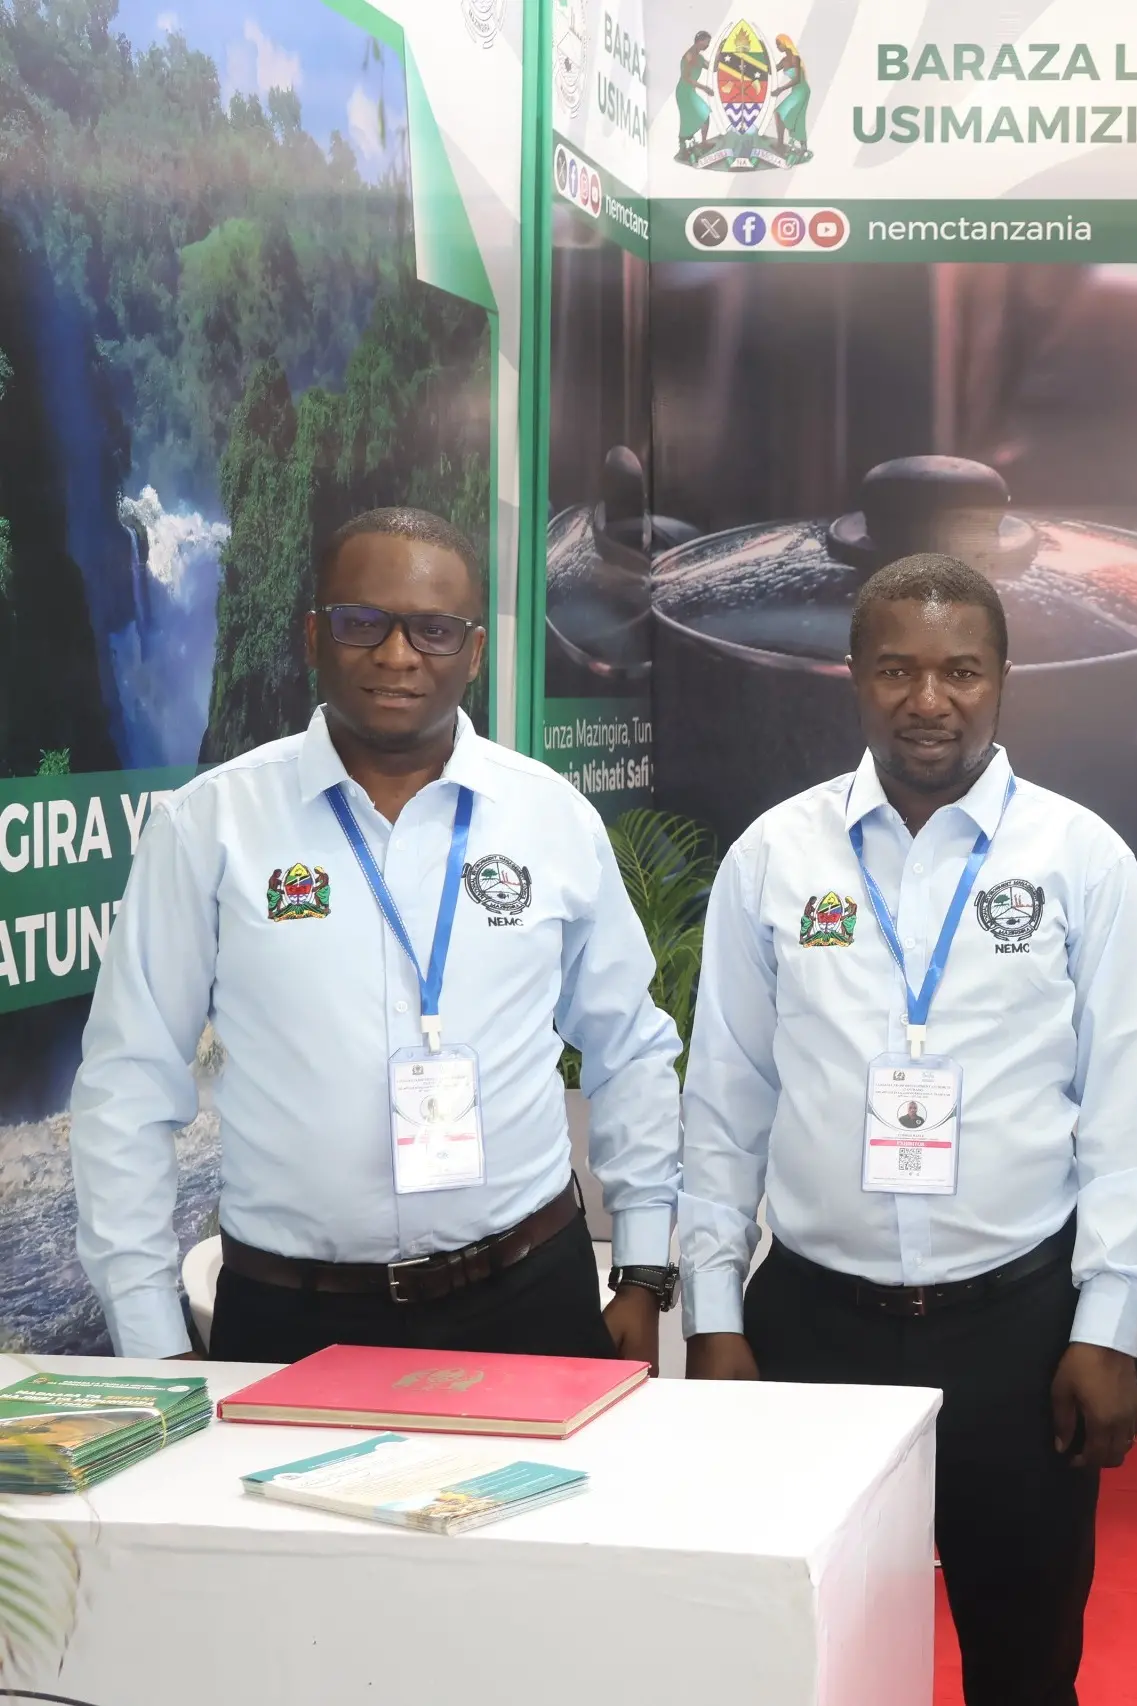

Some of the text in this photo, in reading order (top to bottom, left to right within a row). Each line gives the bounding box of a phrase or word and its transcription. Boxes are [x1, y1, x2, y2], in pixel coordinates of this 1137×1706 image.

[877, 42, 1101, 82] BARAZA
[852, 105, 1137, 145] USIMAMIZI
[868, 215, 1092, 242] nemctanzania
[543, 716, 653, 753] unza Mazingira, Tun
[583, 757, 625, 794] Nishati
[627, 755, 649, 789] Safi
[487, 916, 524, 927] NEMC
[0, 899, 122, 986] ATUN
[994, 943, 1030, 954] NEMC
